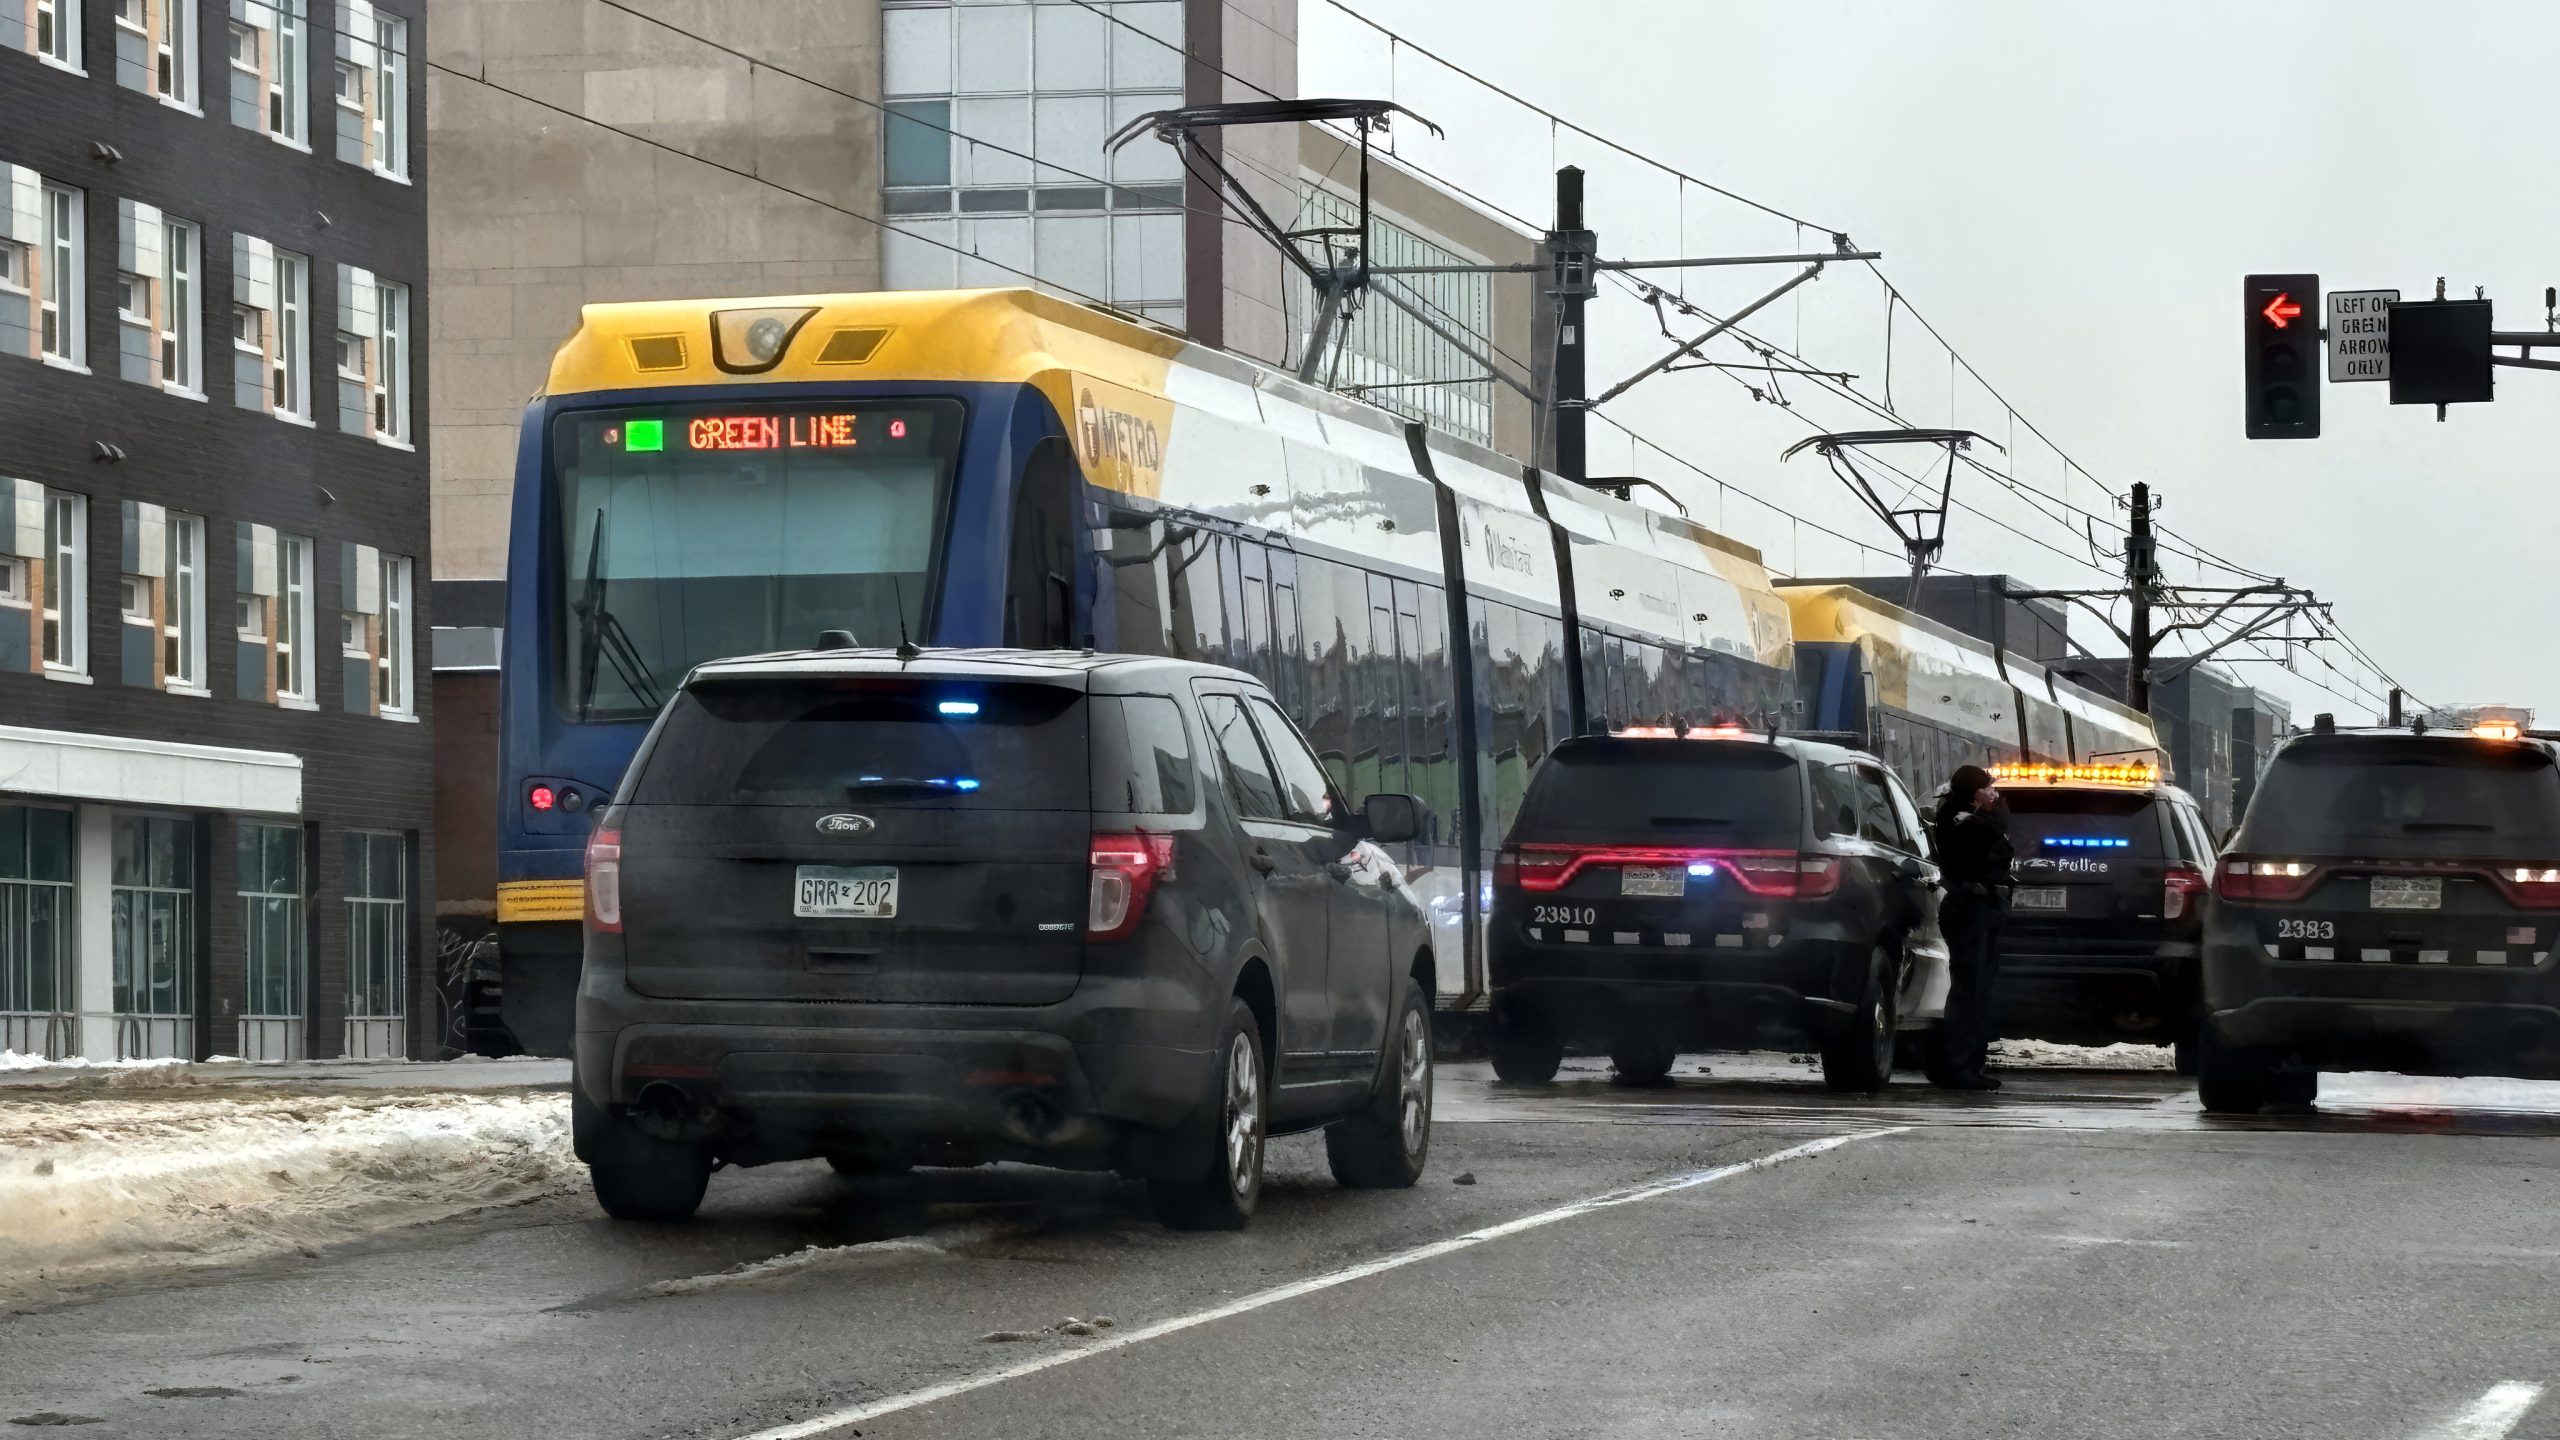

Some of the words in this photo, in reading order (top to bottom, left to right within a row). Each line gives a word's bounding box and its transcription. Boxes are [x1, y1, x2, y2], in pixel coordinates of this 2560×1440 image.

[2335, 297, 2366, 314] LEFT
[2342, 316, 2387, 334] GREEN
[2339, 338, 2391, 355] ARROW
[2347, 359, 2384, 376] ONLY
[689, 416, 779, 449] GREEN
[789, 414, 857, 447] LINE
[1101, 405, 1158, 472] METRO
[1534, 905, 1596, 925] 23810
[2278, 918, 2335, 939] 2383
